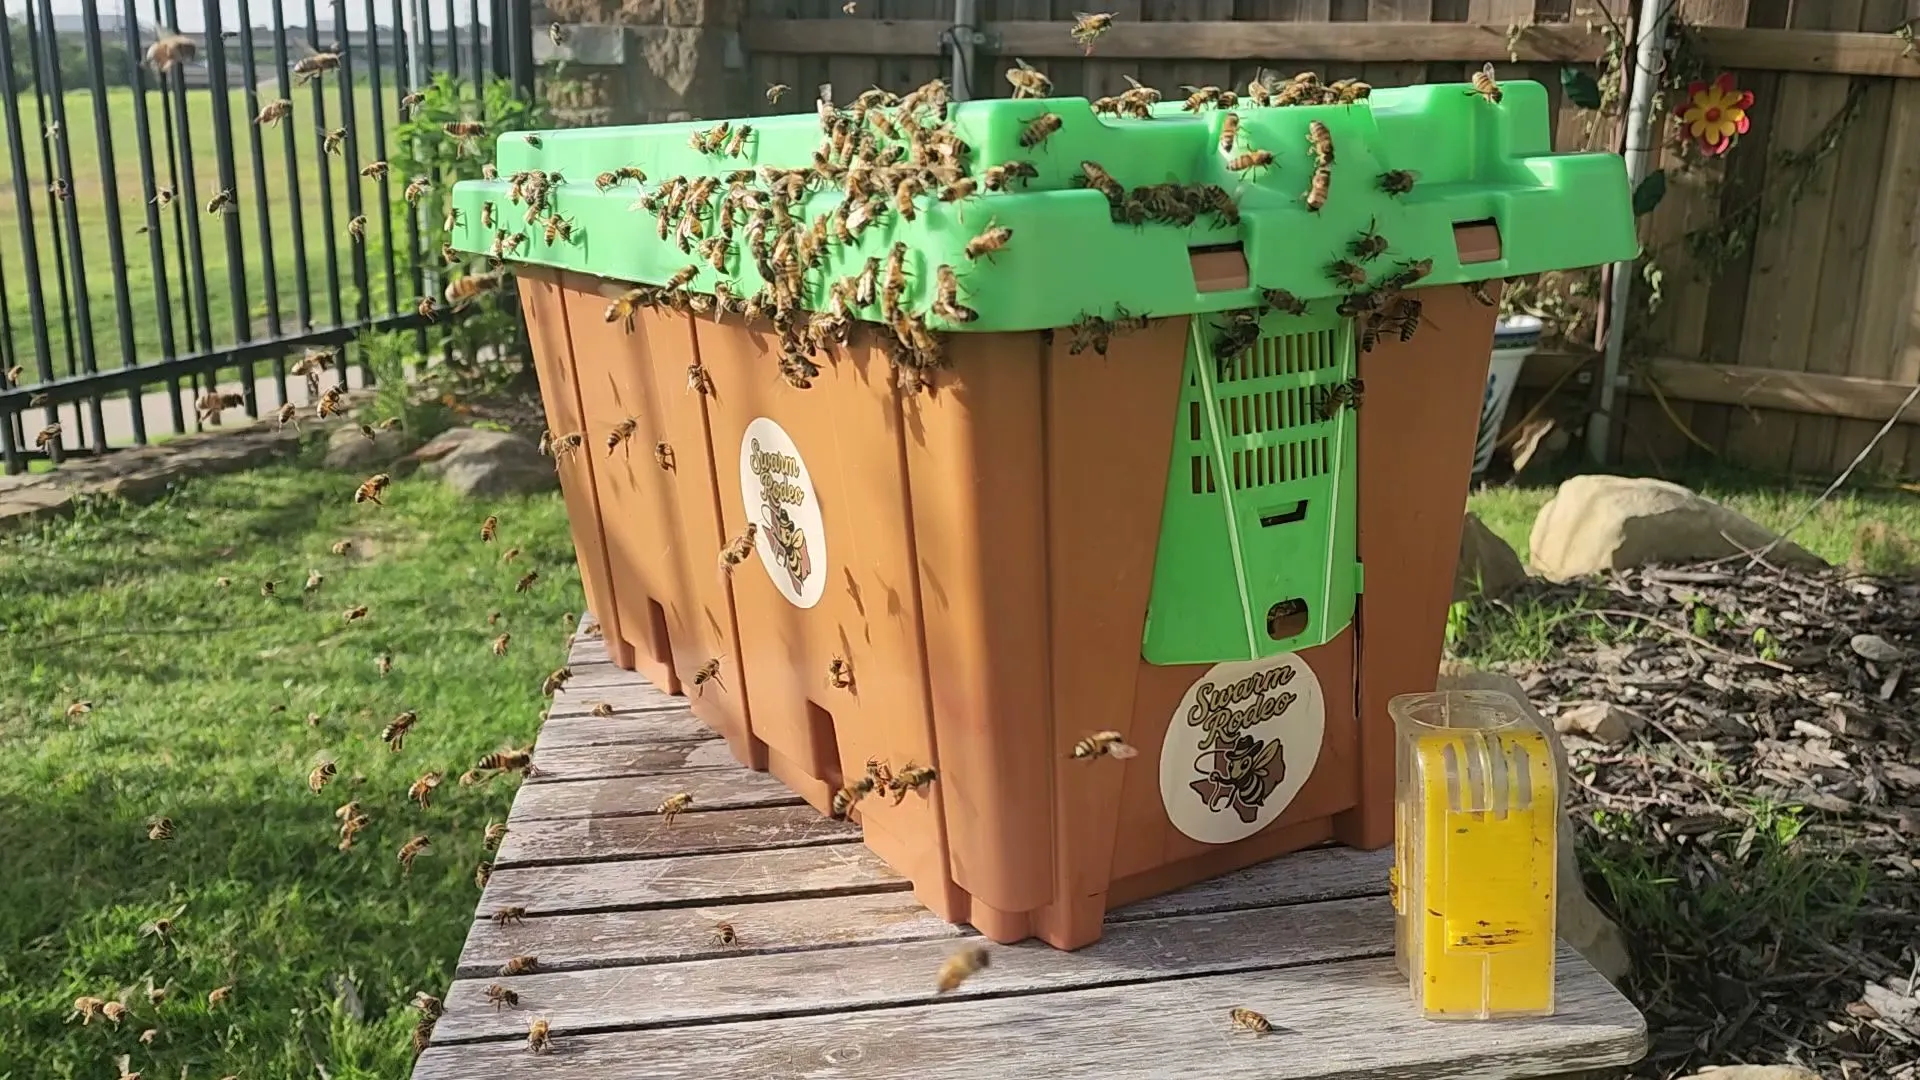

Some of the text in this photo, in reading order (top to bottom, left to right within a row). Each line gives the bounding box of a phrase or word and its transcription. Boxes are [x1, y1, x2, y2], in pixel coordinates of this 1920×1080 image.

[750, 438, 800, 478] Swarm
[760, 472, 804, 506] Rodeo
[1187, 665, 1296, 726] Swarm
[1198, 692, 1297, 750] Rodeo
